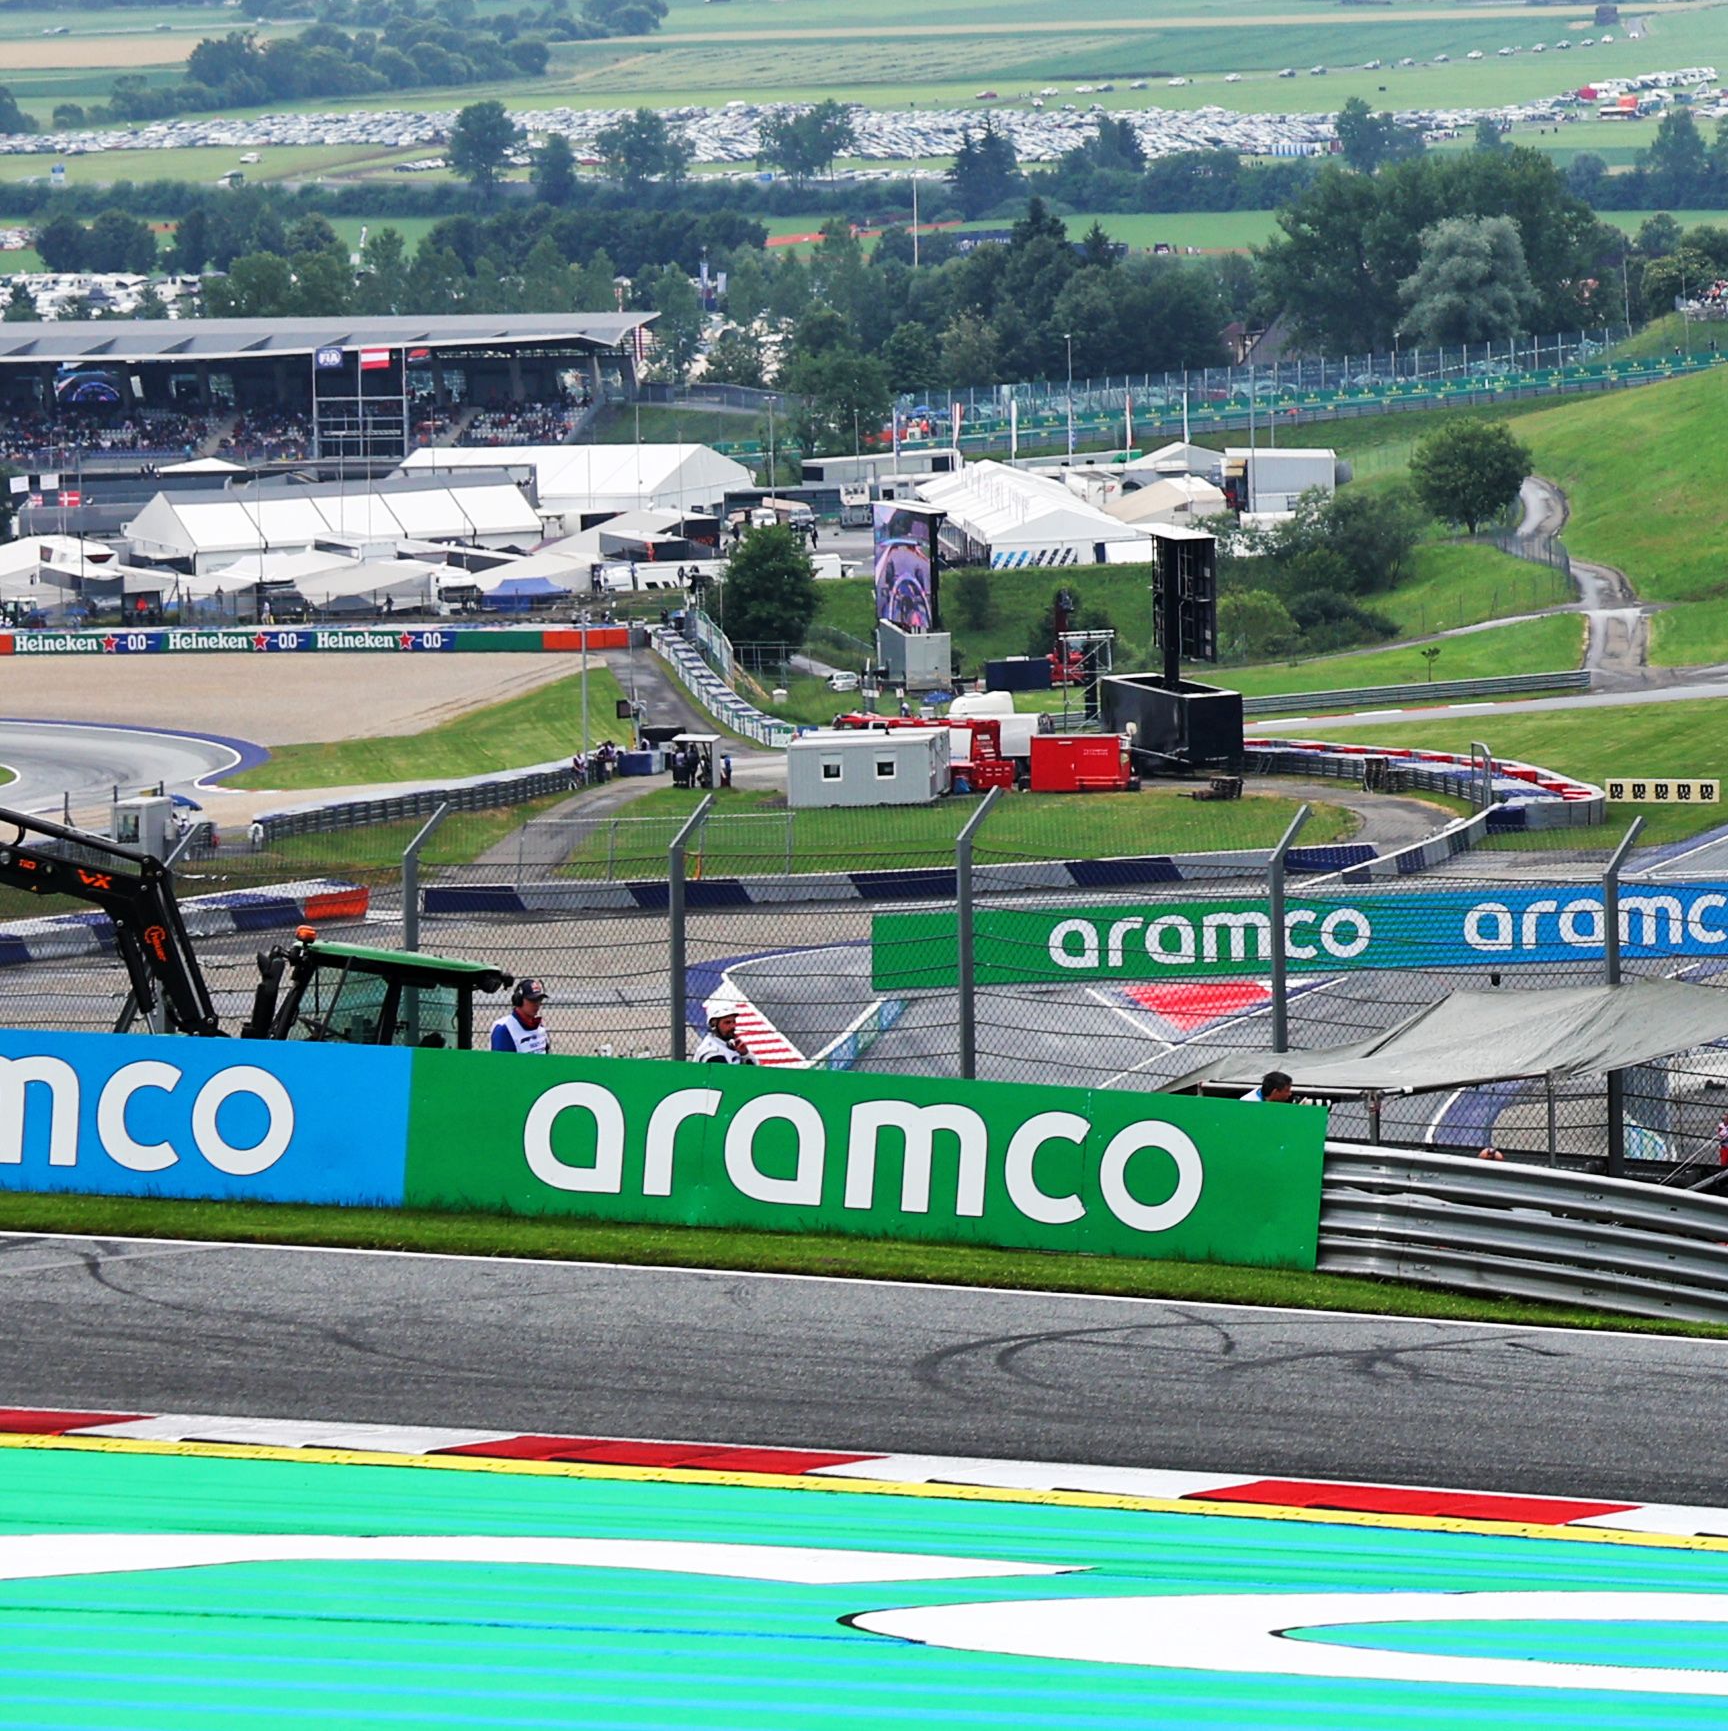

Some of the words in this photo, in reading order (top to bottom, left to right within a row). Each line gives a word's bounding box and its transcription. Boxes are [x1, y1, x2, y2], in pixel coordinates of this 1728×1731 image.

[318, 352, 341, 363] FIA
[15, 635, 98, 652] Heineken
[168, 633, 248, 649] Heineken
[317, 631, 394, 648] Heineken
[1049, 909, 1370, 968] aramco
[524, 1082, 1203, 1231] aramco
